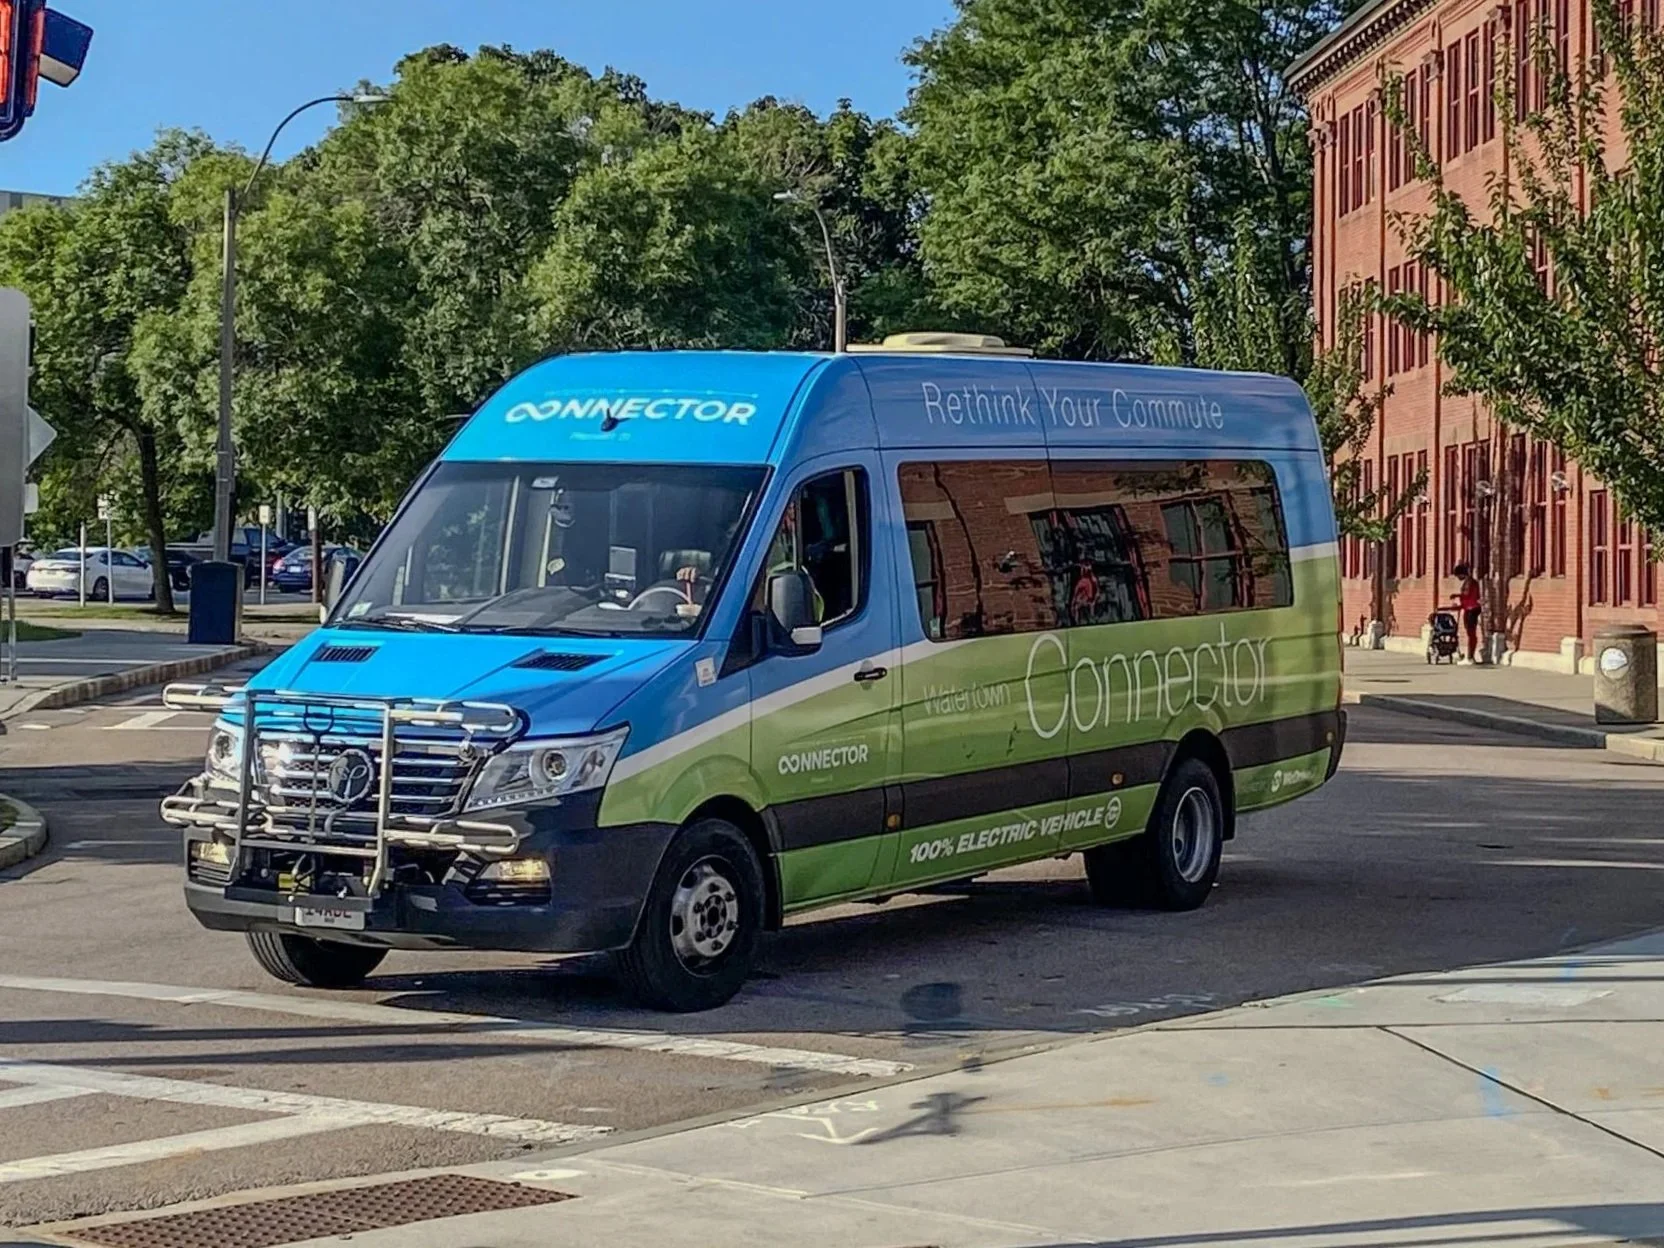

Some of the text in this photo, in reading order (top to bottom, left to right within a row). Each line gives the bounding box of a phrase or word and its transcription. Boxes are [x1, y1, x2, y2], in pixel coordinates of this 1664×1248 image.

[921, 381, 1224, 430] Rethink Your Commute
[923, 621, 1272, 739] Watertown Connector
[909, 806, 1105, 863] 100% ELECTRIC VEHICLE
